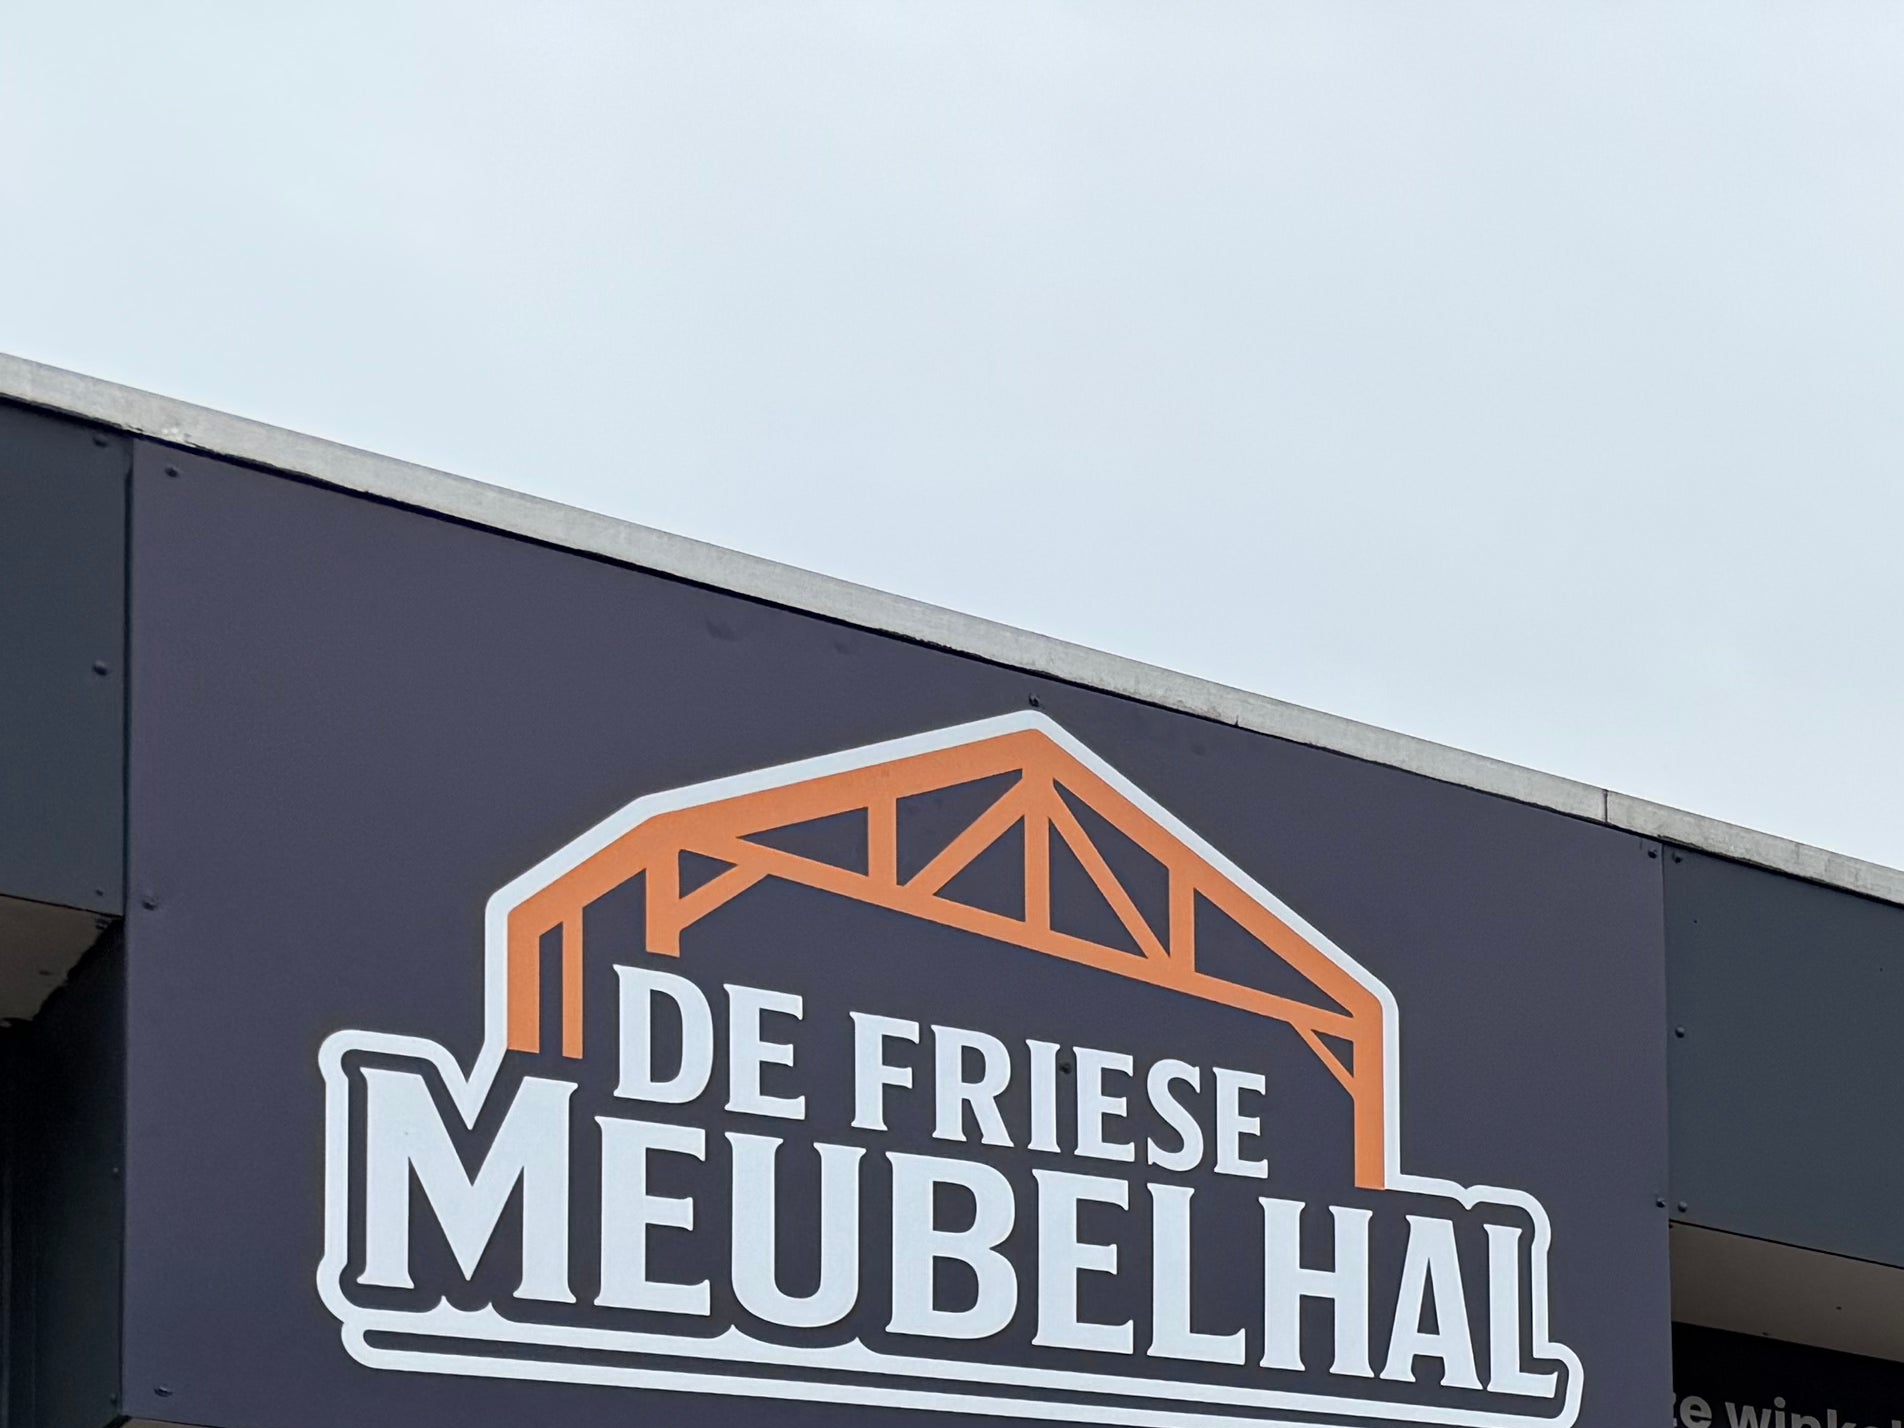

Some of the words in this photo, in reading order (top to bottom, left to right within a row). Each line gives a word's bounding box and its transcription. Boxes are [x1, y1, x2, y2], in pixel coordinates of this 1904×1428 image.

[613, 962, 807, 1122] DE
[849, 1011, 1269, 1181] FRIESE
[354, 1065, 1560, 1400] MEUBELHAL
